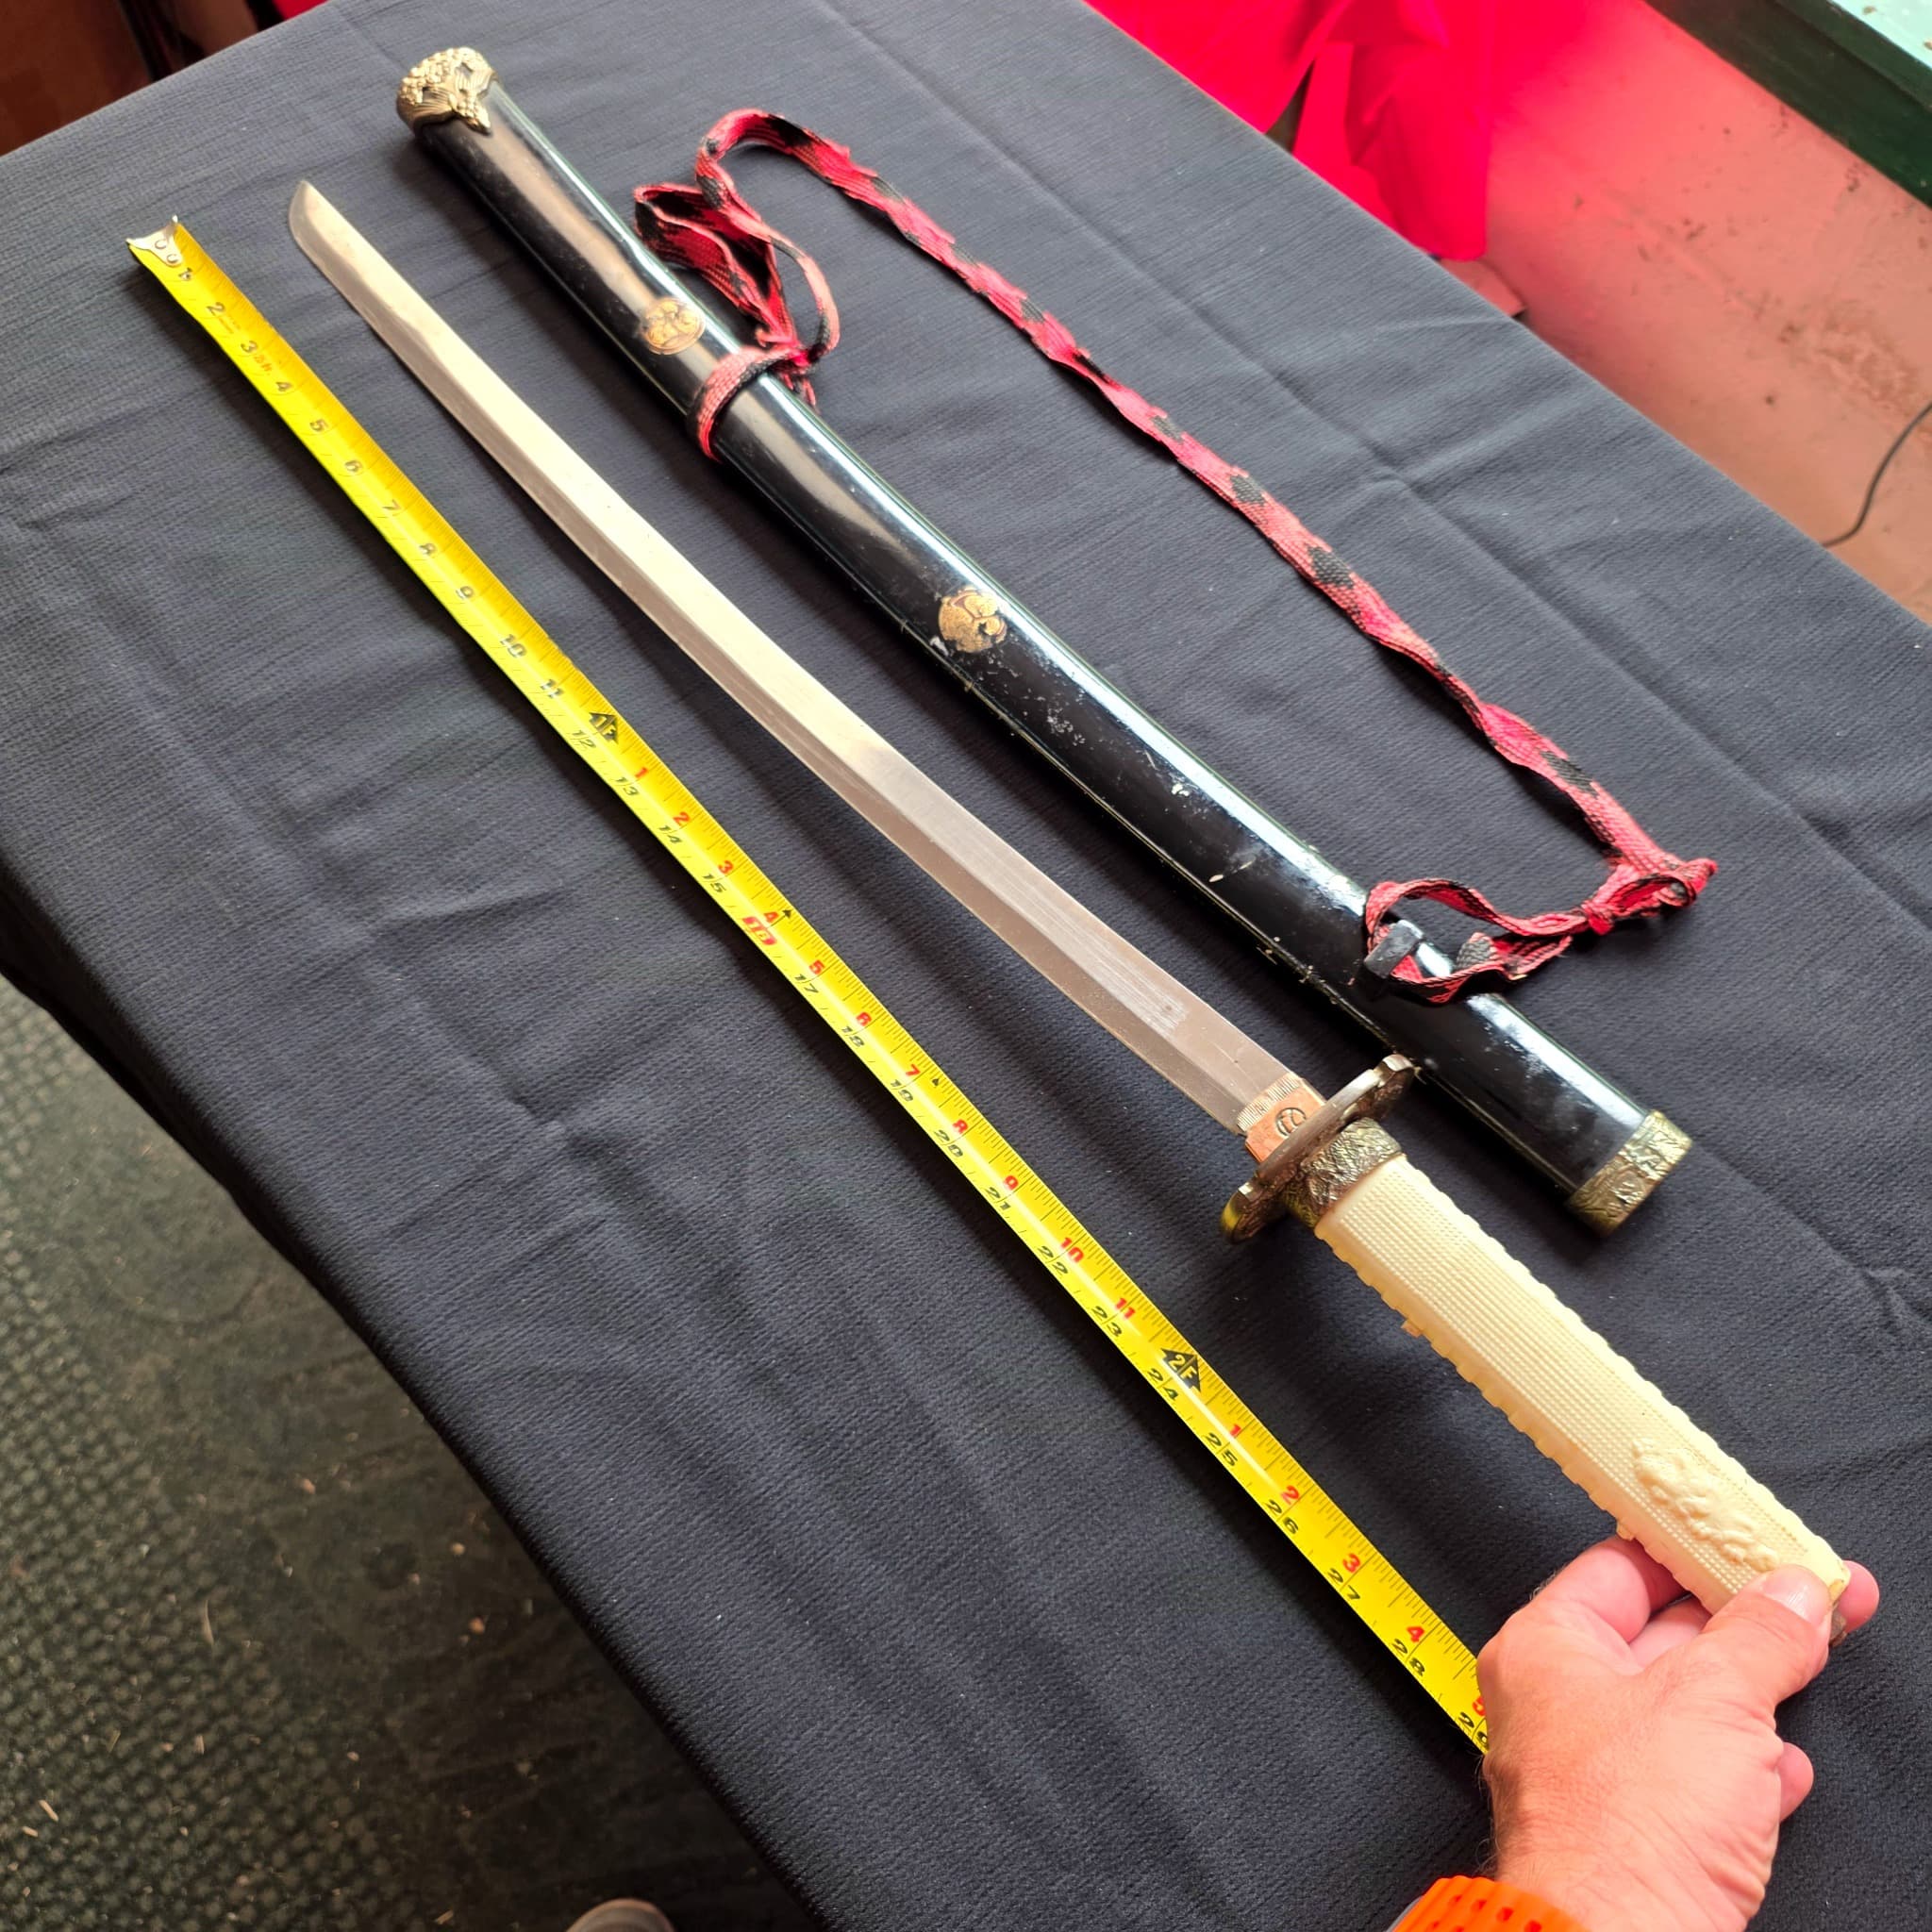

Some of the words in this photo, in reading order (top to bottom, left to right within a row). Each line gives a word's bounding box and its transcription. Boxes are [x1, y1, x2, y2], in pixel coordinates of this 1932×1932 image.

[207, 302, 225, 315] 2
[241, 341, 258, 354] 3
[275, 381, 292, 392] 4
[309, 419, 328, 432] 5
[344, 460, 362, 473] 6
[382, 499, 401, 511] 7
[419, 542, 437, 556] 8
[456, 586, 475, 599] 9
[500, 633, 527, 658] 10
[541, 678, 564, 699] 11
[572, 730, 596, 750] 12
[635, 767, 649, 778] 1
[615, 776, 640, 796] 13
[674, 811, 691, 826] 2
[658, 825, 682, 844] 14
[718, 860, 734, 875] 3
[703, 873, 726, 893] 15
[763, 911, 779, 923] 4
[808, 959, 825, 974] 5
[794, 974, 819, 993] 17
[857, 1011, 873, 1026] 6
[841, 1026, 865, 1047] 18
[906, 1063, 921, 1077] 7
[891, 1079, 914, 1102] 19
[935, 1130, 963, 1158] 20
[1003, 1175, 1019, 1191] 9
[986, 1187, 1011, 1210] 21
[1060, 1237, 1084, 1263] 10
[1038, 1245, 1069, 1275] 22
[1116, 1297, 1136, 1320] 11
[1091, 1306, 1123, 1337] 23
[1147, 1368, 1178, 1401] 24
[1229, 1424, 1242, 1438] 1
[1205, 1432, 1238, 1466] 25
[1280, 1485, 1300, 1505] 2
[1265, 1499, 1299, 1534] 26
[1342, 1553, 1361, 1574] 3
[1327, 1568, 1361, 1600] 27
[1407, 1625, 1425, 1643] 4
[1392, 1639, 1425, 1676] 28
